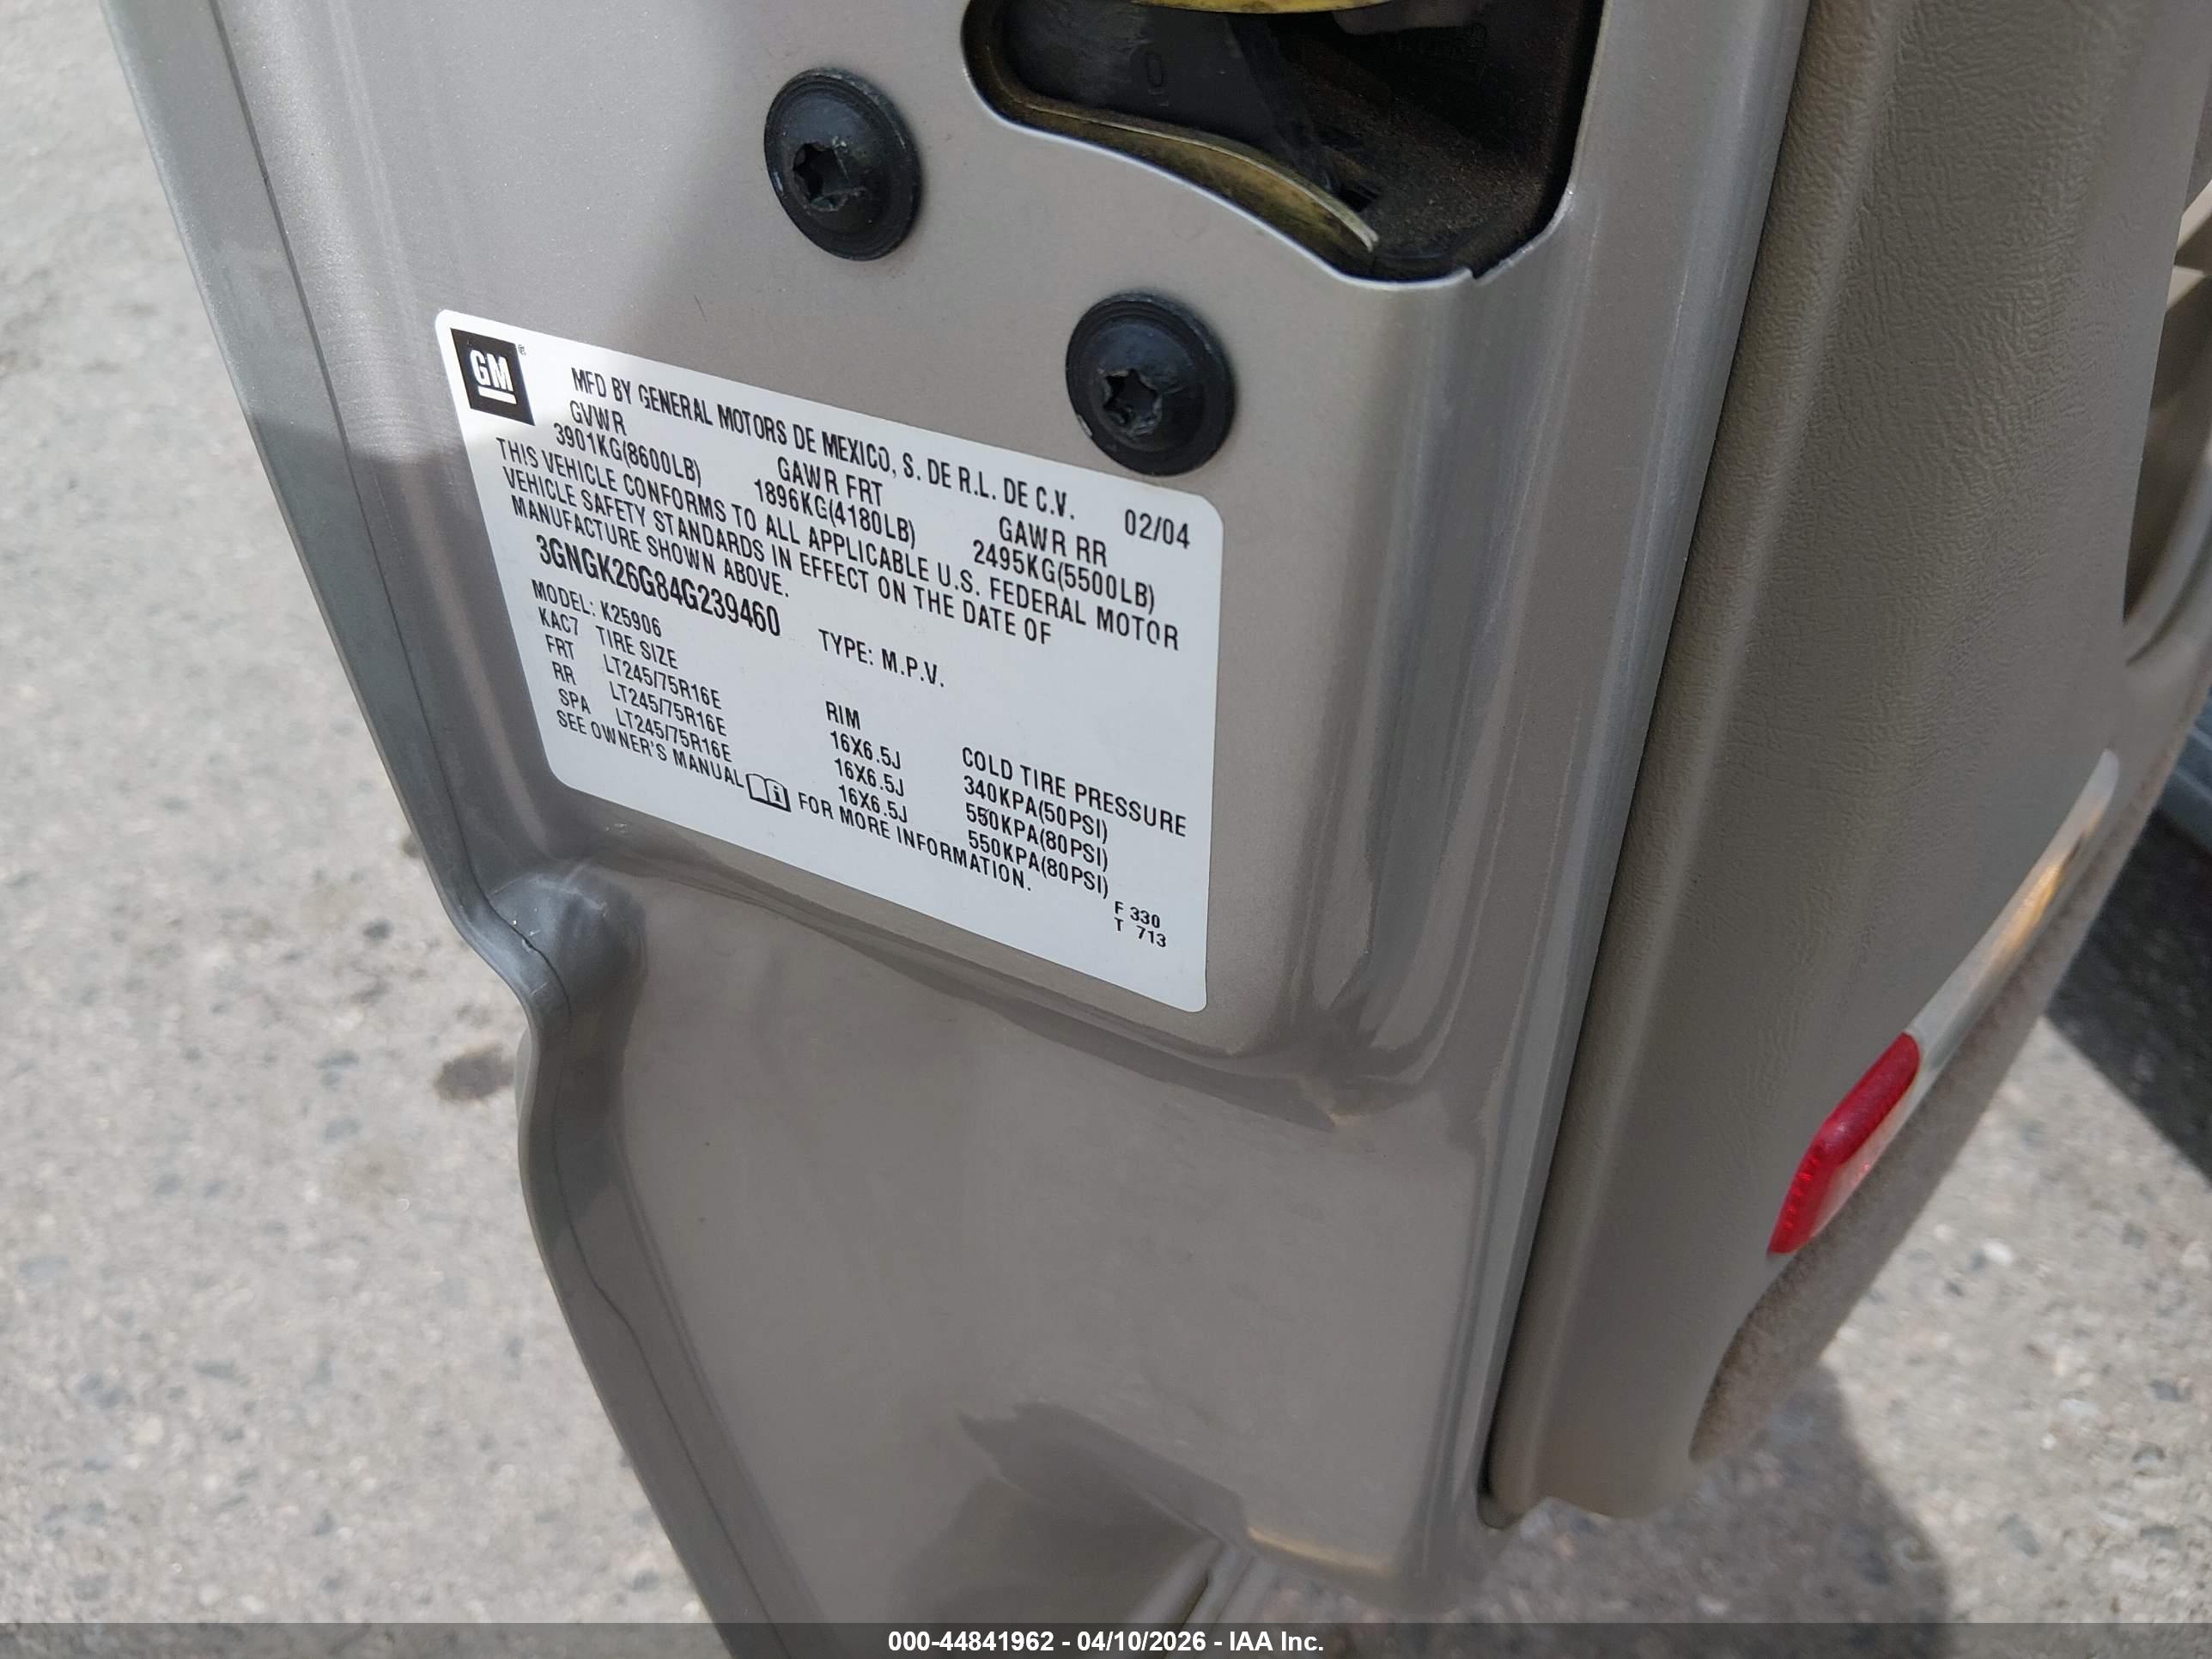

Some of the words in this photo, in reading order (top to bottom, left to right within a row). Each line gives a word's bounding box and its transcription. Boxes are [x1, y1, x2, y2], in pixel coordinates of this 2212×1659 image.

[470, 349, 514, 392] GM
[569, 399, 628, 437] GVWR
[570, 367, 607, 398] MFD
[611, 376, 632, 405] BY
[637, 383, 714, 427] GENERAL
[716, 404, 788, 446] MOTORS
[792, 423, 817, 454] DE
[821, 430, 897, 477] MEXICO,
[902, 452, 921, 482] S.
[927, 458, 952, 489] DE
[957, 465, 997, 501] R.L.
[1003, 477, 1029, 509] DE
[1036, 485, 1075, 520] C.V.
[553, 422, 702, 489] 3901KG(8600LB)
[777, 455, 840, 496] GAWR
[845, 473, 884, 507] FRT
[495, 436, 539, 469] THIS
[540, 449, 618, 493] VEHICLE
[623, 472, 727, 523] CONFORMS
[730, 502, 757, 532] TO
[765, 514, 801, 545] ALL
[808, 526, 930, 582] APPLICABLE
[937, 562, 981, 597] U.S.
[989, 576, 1087, 626] FEDERAL
[1097, 605, 1179, 652] MOTOR
[511, 494, 642, 553] MANUFACTURE
[646, 534, 716, 576] SHOWN
[723, 558, 789, 599] ABOVE.
[753, 478, 916, 550] 1896KG(4180LB)
[999, 515, 1067, 557] GAWR
[1076, 535, 1108, 568] RR
[1124, 508, 1191, 550] 02/04
[501, 465, 578, 508] VEHICLE
[580, 489, 646, 528] SAFETY
[652, 509, 765, 563] STANDARDS
[771, 543, 793, 572] IN
[799, 551, 870, 594] EFFECT
[878, 575, 907, 605] ON
[913, 584, 955, 619] THE
[963, 599, 1017, 637] DATE
[1024, 617, 1052, 645] OF
[536, 534, 781, 637] 3GNGK26G84G239460
[972, 538, 1155, 616] 2495KG(5500LB)
[531, 579, 596, 617] MODEL:
[599, 599, 662, 638] K25906
[538, 606, 579, 636] KAC7
[594, 624, 636, 656] TIRE
[639, 640, 678, 670] SIZE
[544, 634, 574, 660] FRT
[603, 653, 722, 710] LT245/75R16E
[817, 628, 874, 666] TYPE:
[881, 647, 945, 688] M.P.V.
[551, 660, 577, 686] RR
[609, 680, 727, 738] LT245/75R16E
[557, 688, 592, 714] SPA
[615, 707, 732, 763] LT245/75R16E
[825, 700, 861, 731] RIM
[830, 730, 902, 770] 16X6.5J
[834, 757, 904, 798] 16X6.5J
[556, 709, 587, 735] SEE
[590, 720, 667, 762] OWNER'S
[672, 747, 744, 789] MANUAL
[798, 791, 835, 820] FOR
[838, 805, 891, 840] MORE
[896, 825, 1031, 891] INFORMATION.
[838, 784, 908, 823] 16X6.5J
[962, 746, 1013, 781] COLD
[1019, 764, 1066, 799] TIRE
[1074, 781, 1187, 838] PRESSURE
[963, 775, 1108, 845] 340KPA(50PSI)
[965, 801, 1109, 873] 550KPA(80PSI)
[968, 829, 1109, 900] 550KPA(80PSI)
[1114, 916, 1124, 933] T
[1135, 924, 1167, 948] 713
[1115, 900, 1124, 915] F
[1129, 906, 1161, 929] 330
